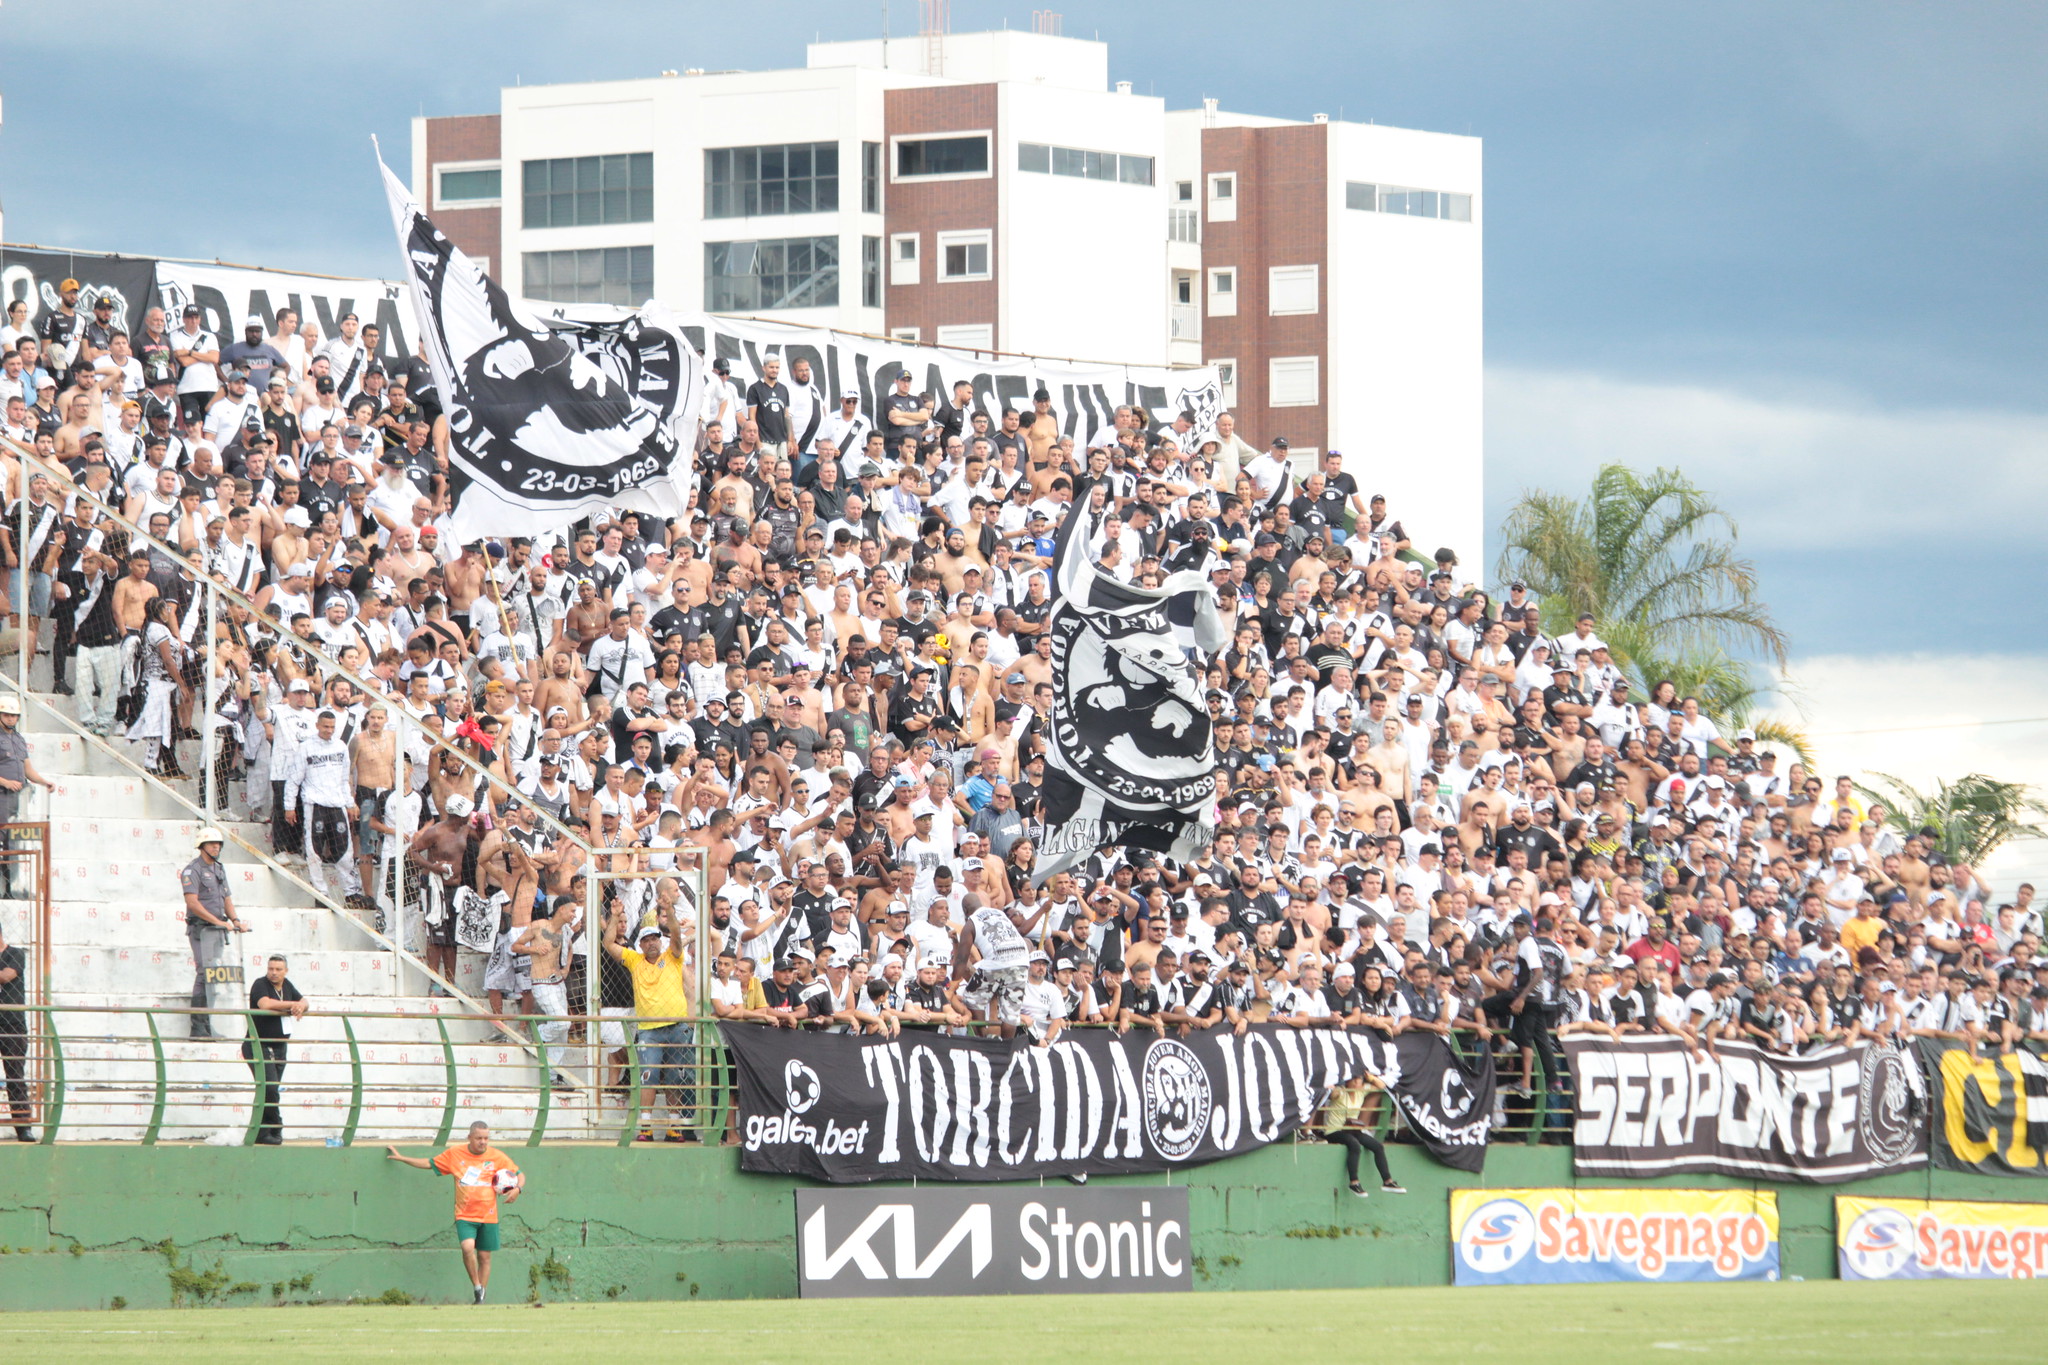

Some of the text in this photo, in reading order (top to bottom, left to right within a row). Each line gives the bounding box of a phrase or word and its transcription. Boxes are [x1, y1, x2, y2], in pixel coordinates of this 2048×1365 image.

[1148, 1043, 1175, 1071] JOVEM
[861, 1038, 1143, 1167] TORCIDA
[1576, 1049, 1861, 1158] SERPONTE
[1019, 1201, 1184, 1282] Stonic
[1538, 1204, 1768, 1279] Savegnago
